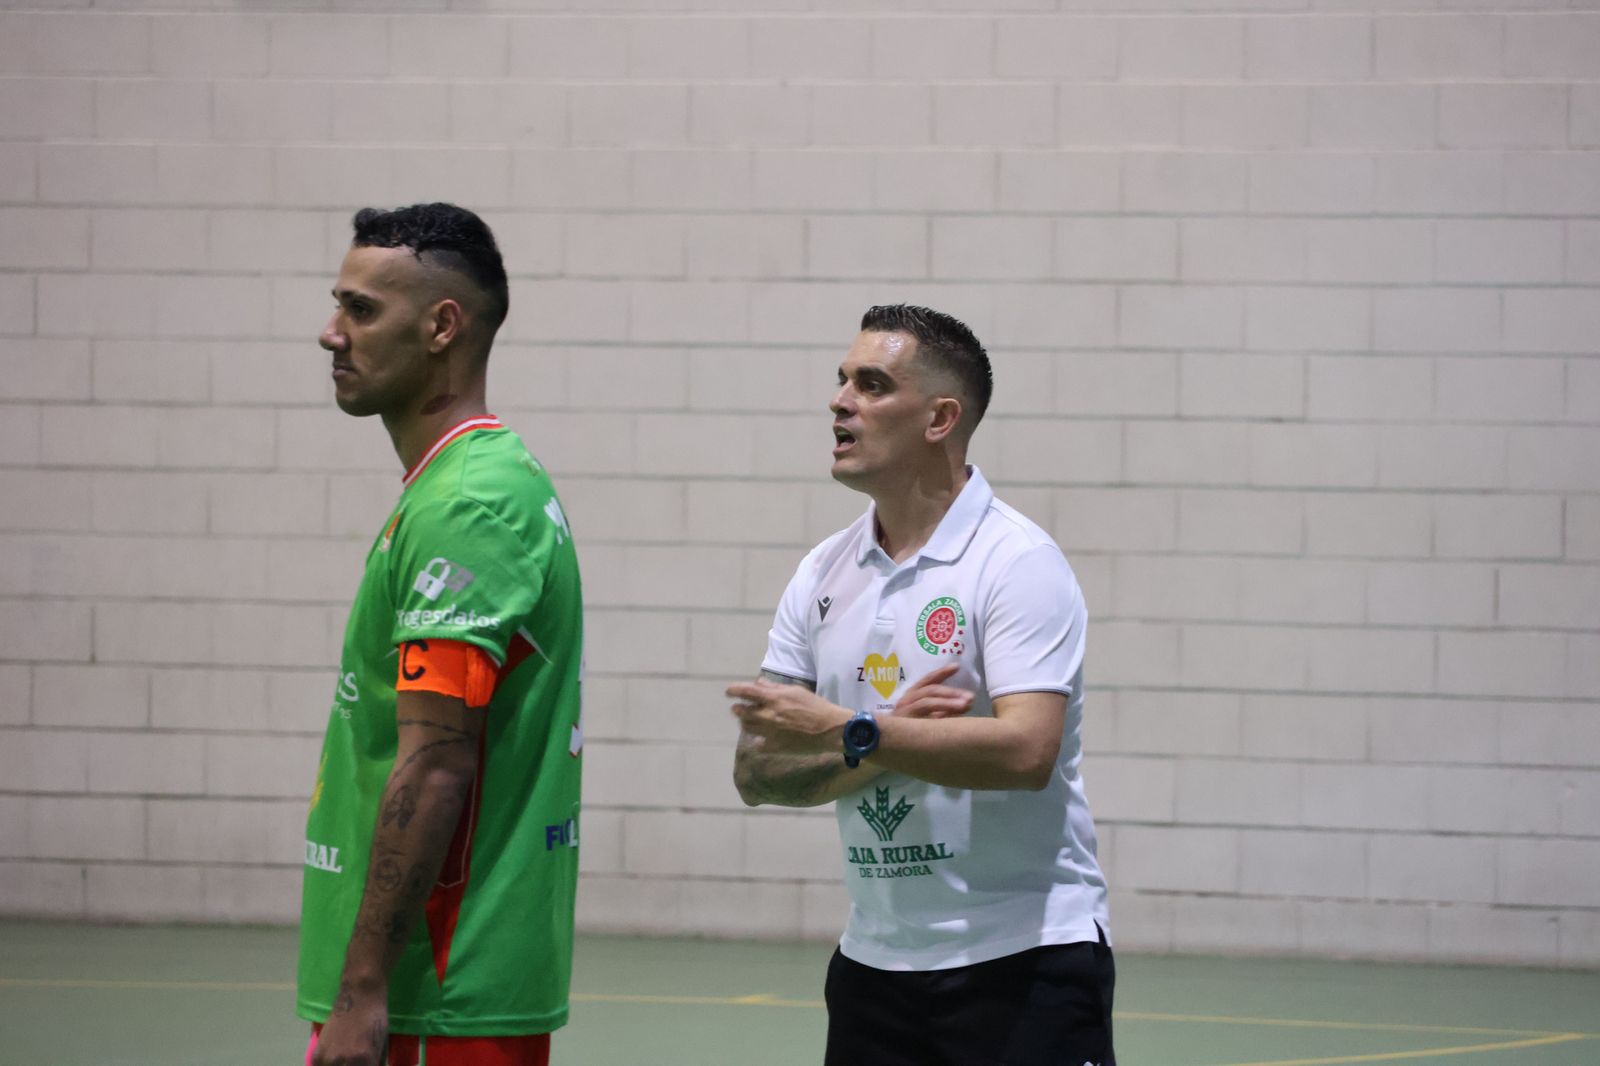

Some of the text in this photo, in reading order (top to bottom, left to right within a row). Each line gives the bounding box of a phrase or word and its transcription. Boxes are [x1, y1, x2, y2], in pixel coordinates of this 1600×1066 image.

[402, 639, 429, 680] C
[881, 842, 954, 864] RURAL
[859, 864, 934, 879] DE ZAMORA
